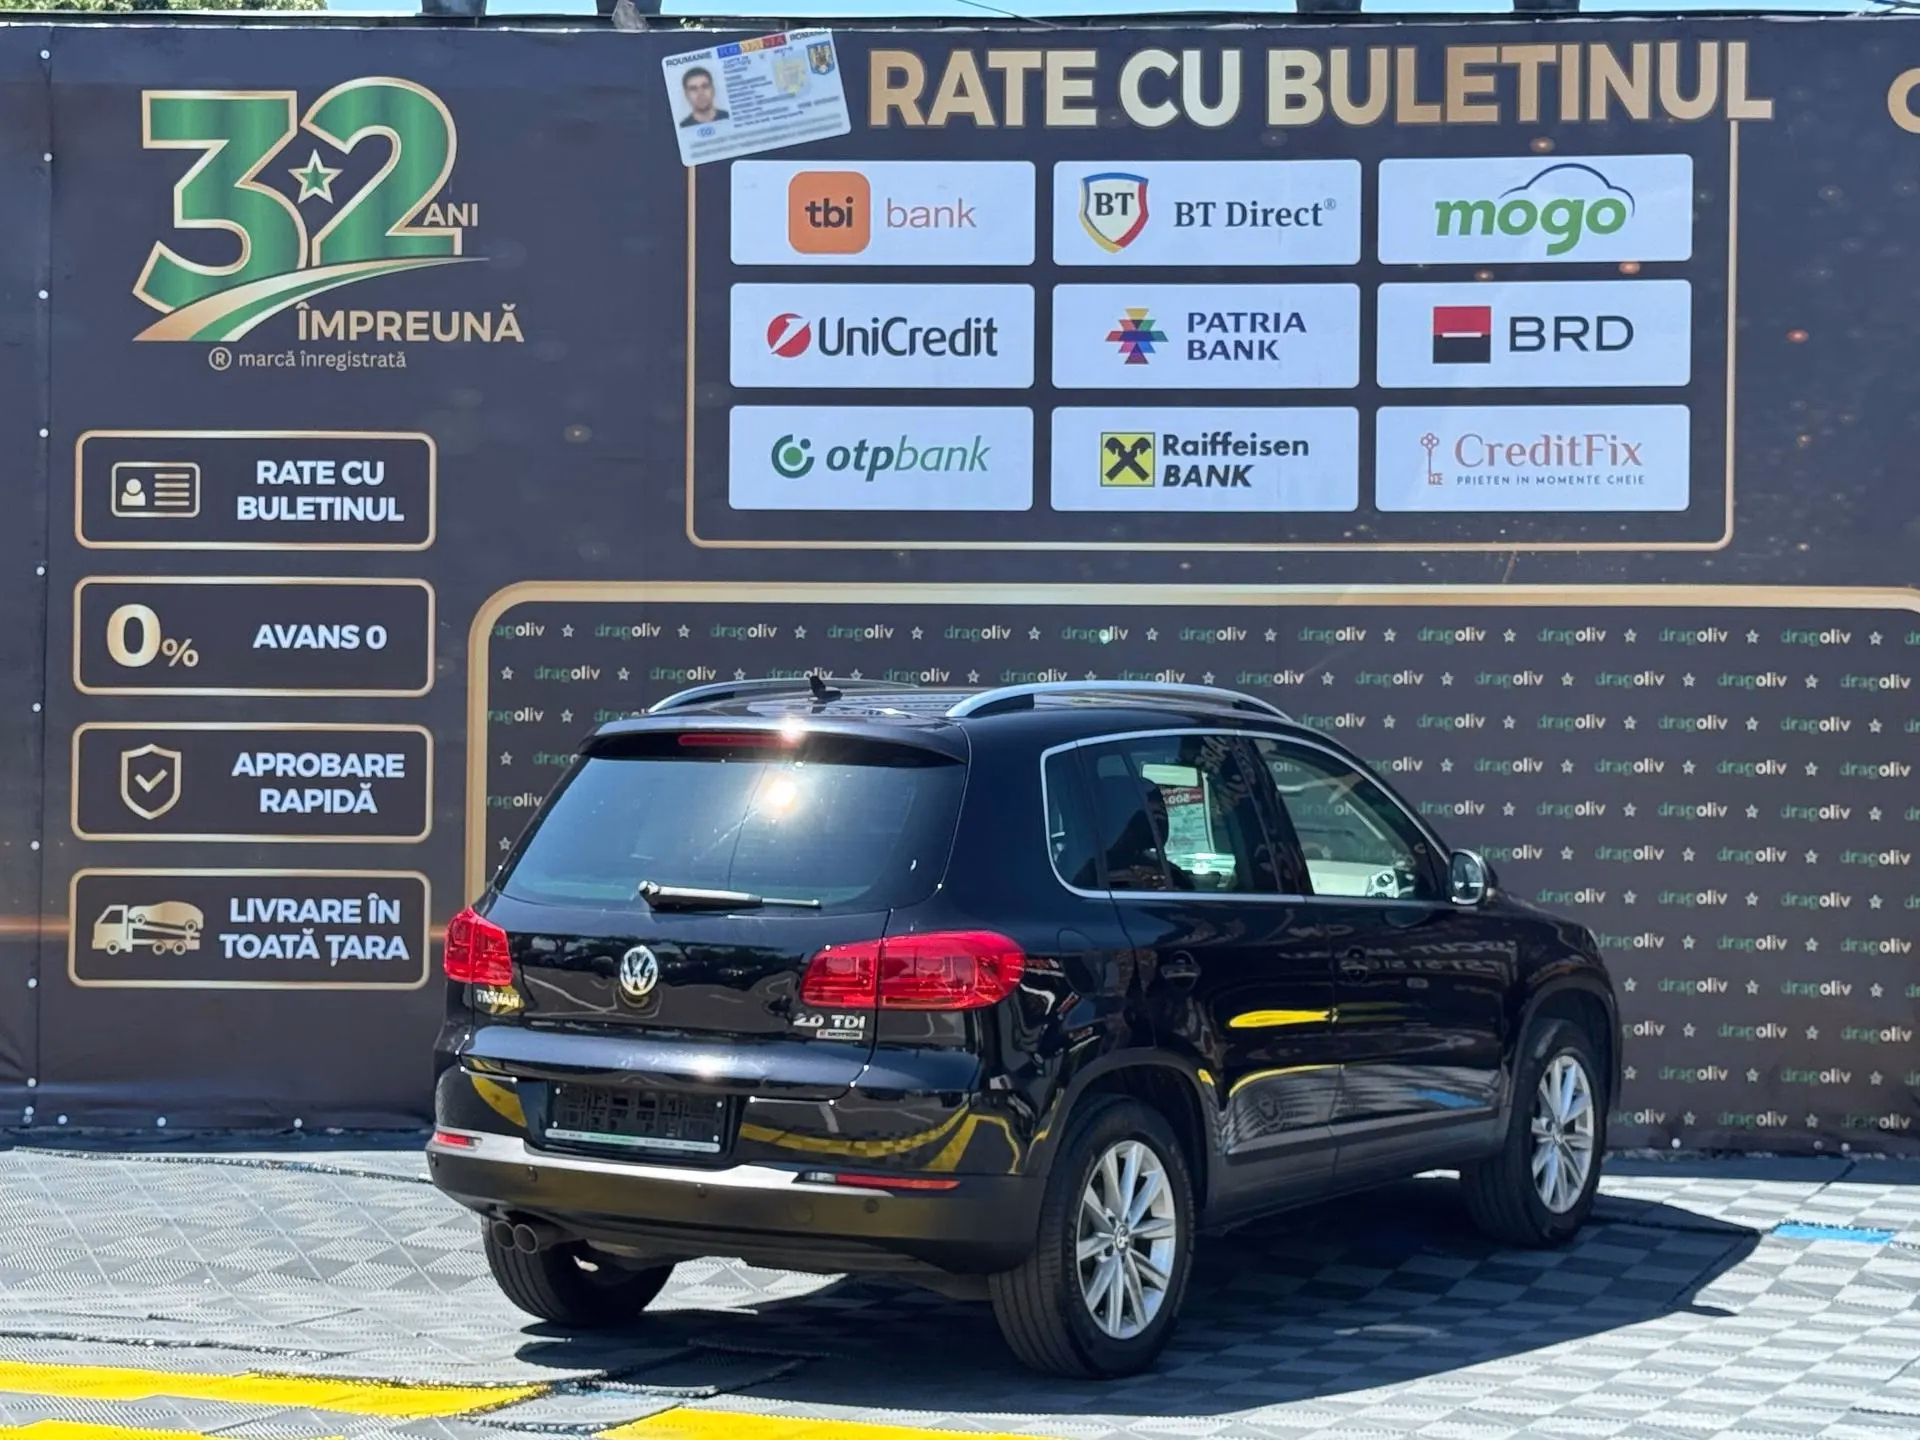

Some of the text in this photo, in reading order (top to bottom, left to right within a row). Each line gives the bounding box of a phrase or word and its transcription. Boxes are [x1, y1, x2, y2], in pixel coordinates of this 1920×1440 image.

[868, 41, 1774, 127] RATE CU BULETINUL
[133, 76, 463, 315] 32
[1094, 192, 1135, 216] BT
[424, 202, 479, 227] ANI
[805, 196, 853, 229] tbi
[886, 198, 977, 229] bank
[1174, 201, 1217, 227] BT
[1435, 197, 1628, 257] mogo
[296, 301, 525, 343] ÎMPREUNĂ
[1187, 312, 1307, 333] PATRIA
[1509, 315, 1634, 353] BRD
[818, 316, 998, 358] UniCredit
[1187, 339, 1280, 361] BANK
[239, 351, 296, 368] marcă
[300, 351, 407, 371] înregistrată
[1163, 433, 1309, 458] Raiffeisen
[1455, 433, 1644, 468] CreditFix
[826, 435, 991, 483] otpbank
[256, 460, 385, 486] RATE CU
[1162, 464, 1254, 488] BANK
[1457, 475, 1511, 485] PRIETEN
[1536, 475, 1601, 485] MOMENTE
[1607, 475, 1645, 485] CHEIE
[236, 496, 404, 522] BULETINUL
[253, 623, 388, 650] AVANS 0
[595, 622, 661, 640] dragoliv
[710, 623, 778, 641] dragoliv
[827, 624, 895, 642] dragoliv
[944, 625, 1011, 642] dragoliv
[1179, 627, 1247, 644] dragoliv
[1299, 627, 1366, 644] dragoliv
[1417, 627, 1486, 644] dragoliv
[1538, 627, 1606, 645] dragoliv
[1659, 627, 1728, 645] dragoliv
[1781, 628, 1851, 647] dragoliv
[534, 664, 600, 682] dragoliv
[650, 665, 716, 683] dragoliv
[883, 668, 950, 685] dragoliv
[1237, 670, 1305, 687] dragoliv
[1355, 670, 1424, 688] dragoliv
[1475, 671, 1543, 689] dragoliv
[1595, 671, 1665, 689] dragoliv
[1717, 672, 1787, 690] dragoliv
[1840, 674, 1911, 692] dragoliv
[487, 708, 544, 725] ragoliv
[1417, 713, 1485, 731] dragoliv
[1538, 714, 1606, 732] dragoliv
[1659, 714, 1728, 732] dragoliv
[1780, 716, 1851, 734] dragoliv
[232, 752, 405, 778] APROBARE
[1475, 757, 1543, 775] dragoliv
[1595, 758, 1664, 776] dragoliv
[1716, 759, 1787, 777] dragoliv
[1840, 761, 1911, 779] dragoliv
[259, 783, 378, 814] RAPIDĂ
[1417, 800, 1485, 818] dragoliv
[1536, 801, 1605, 819] dragoliv
[1658, 802, 1727, 820] dragoliv
[1781, 803, 1850, 821] dragoliv
[1595, 845, 1664, 863] dragoliv
[1716, 847, 1787, 865] dragoliv
[1840, 849, 1910, 867] dragoliv
[229, 893, 401, 924] LIVRARE ÎN
[1537, 888, 1851, 909] dragoliv dragoliv dragoliv
[220, 929, 320, 960] TOATĂ
[1717, 933, 1787, 951] dragoliv
[1840, 936, 1911, 954] dragoliv
[1658, 977, 1852, 997] dragoliv dragoliv
[792, 1013, 866, 1029] 2.0 TDI
[1718, 1022, 1787, 1040] dragoliv
[1841, 1025, 1912, 1044] dragoliv
[1658, 1066, 1851, 1086] dragoliv dragoliv
[1718, 1110, 1787, 1129] dragoliv
